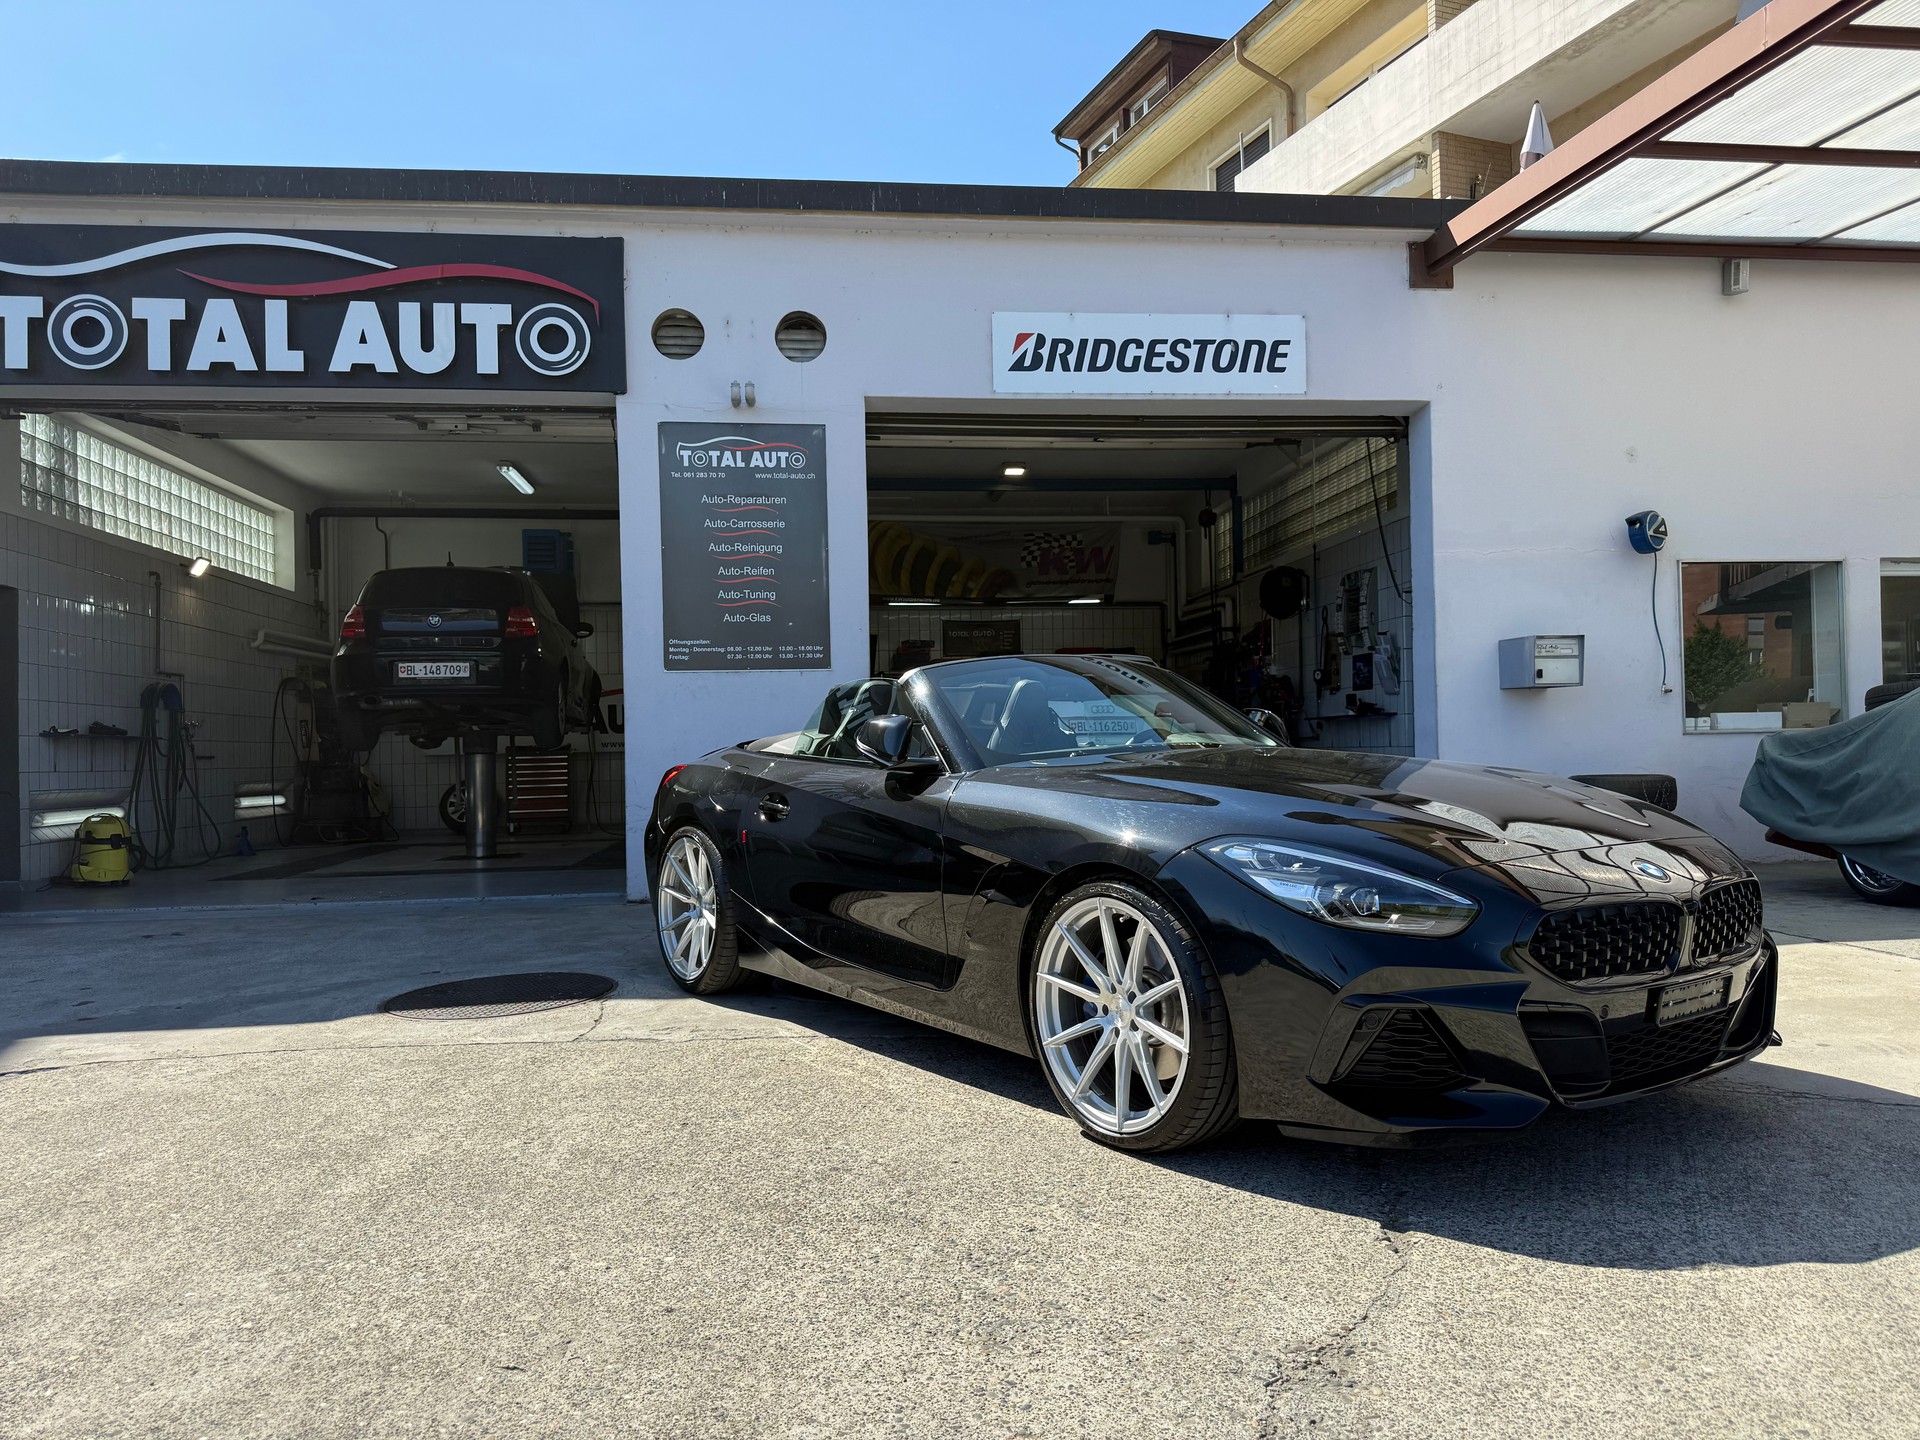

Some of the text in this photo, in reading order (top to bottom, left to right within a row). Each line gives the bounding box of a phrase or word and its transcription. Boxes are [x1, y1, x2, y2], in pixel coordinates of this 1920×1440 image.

[0, 294, 591, 377] TOTAL AUTO
[1007, 332, 1292, 373] BRIDGESTONE
[680, 450, 806, 469] TOTAL AUTO
[755, 472, 816, 480] www.total-auto.ch
[701, 494, 787, 506] Auto-Reparaturen
[704, 518, 786, 529] Auto-Carrosserie
[708, 542, 783, 554] Auto-Reinigung
[1039, 545, 1112, 575] KW
[718, 566, 775, 576] Auto-Reifen
[717, 590, 776, 601] Auto-Tuning
[723, 613, 772, 623] Auto-Glas
